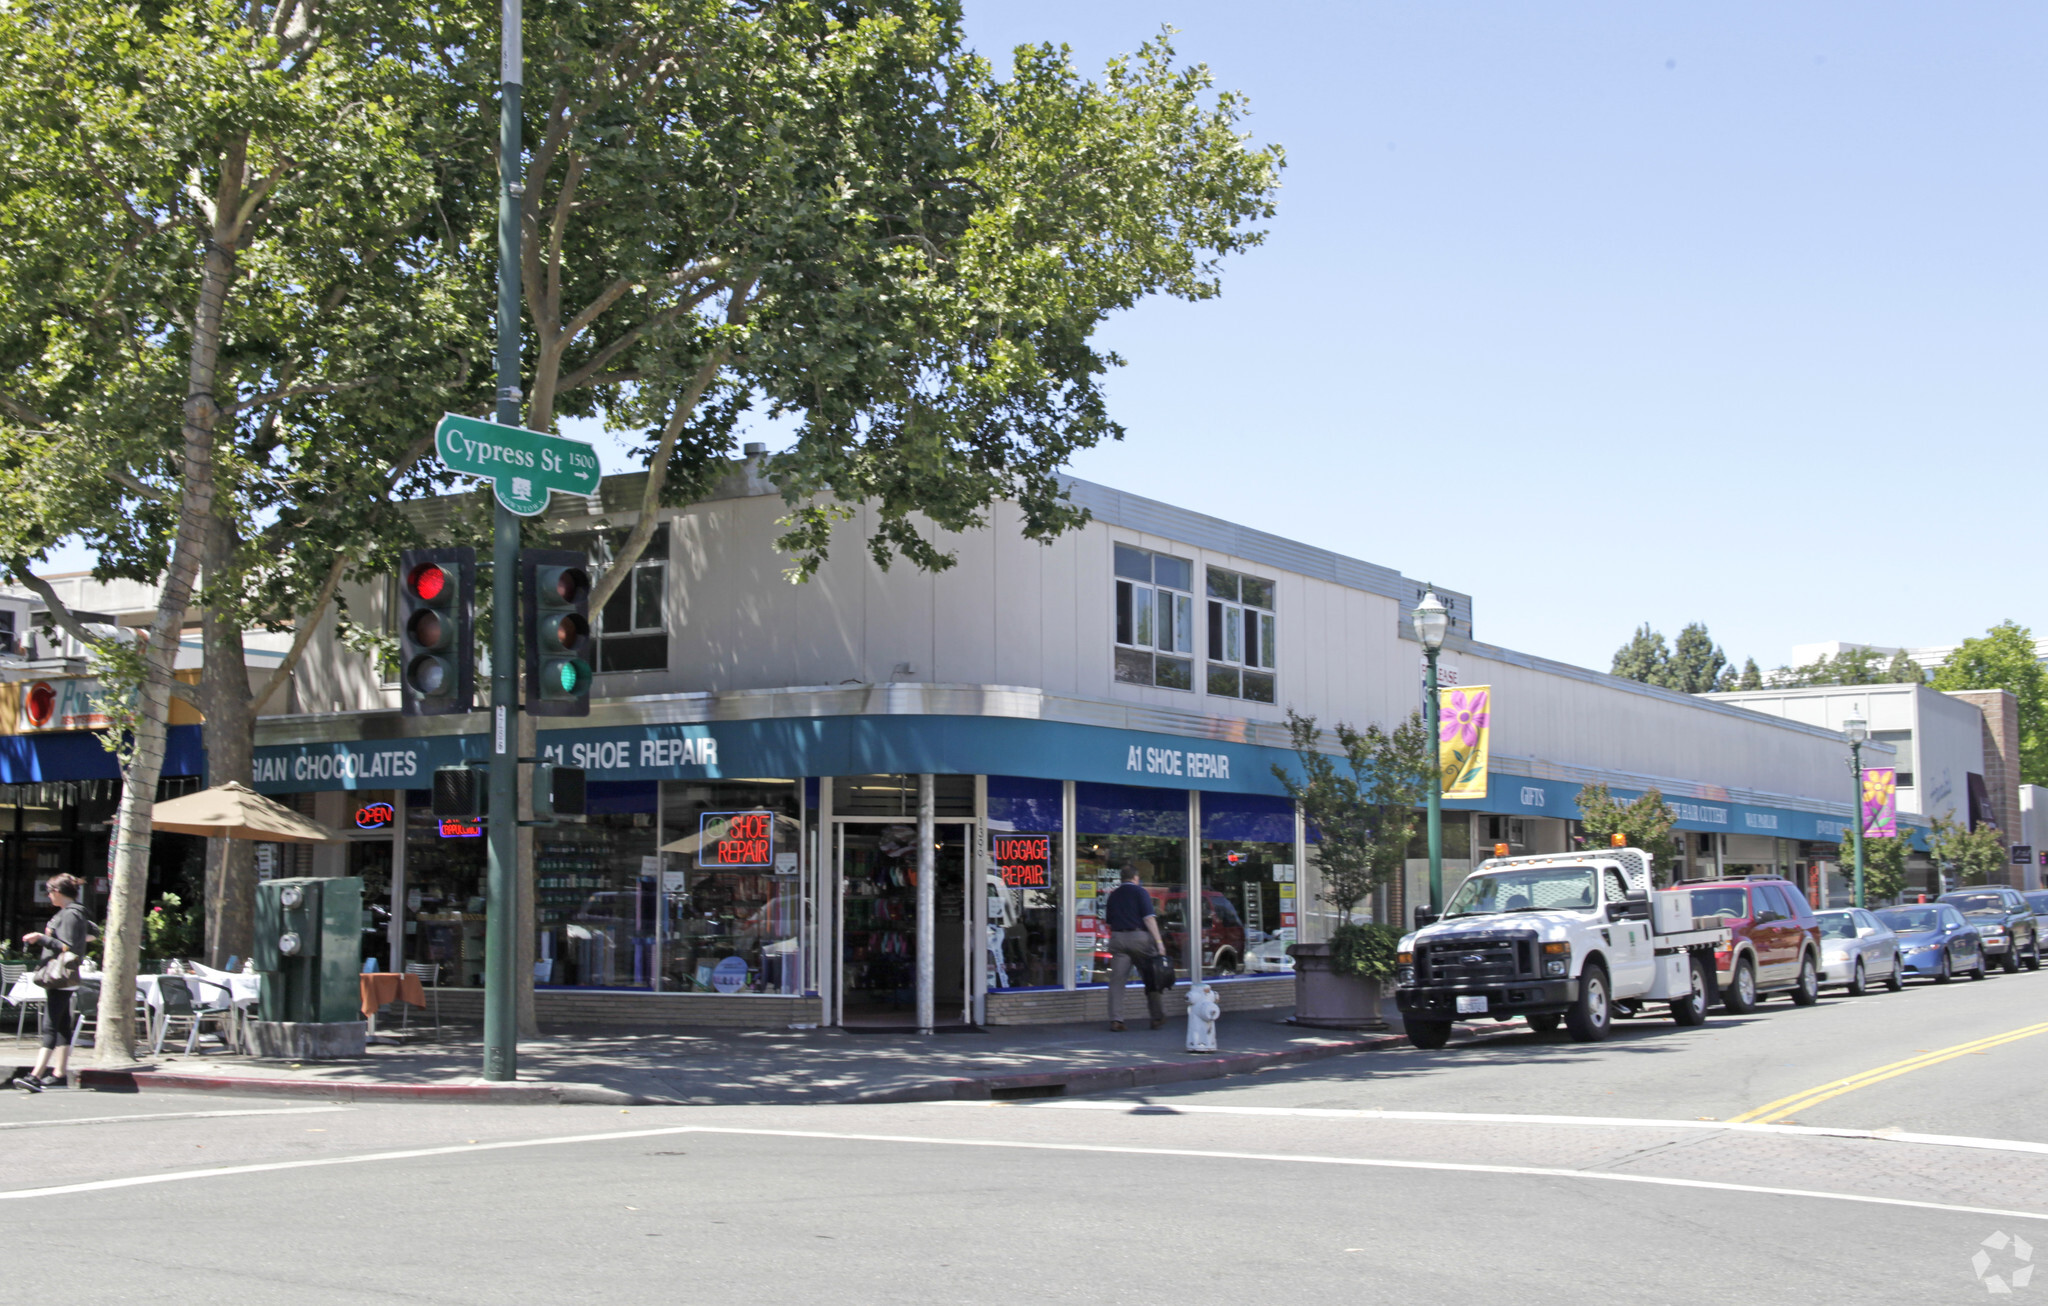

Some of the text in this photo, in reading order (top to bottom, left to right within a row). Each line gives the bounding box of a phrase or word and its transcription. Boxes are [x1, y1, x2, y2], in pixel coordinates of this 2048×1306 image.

[446, 429, 562, 473] Cypress St
[569, 452, 595, 469] 1500
[542, 737, 718, 769] A1 SHOE REPAIR
[1126, 745, 1230, 779] A1 SHOE REPAIR
[295, 750, 417, 780] CHOCOLATES
[1520, 786, 1545, 807] GIFTS
[355, 807, 392, 824] OPEN
[730, 815, 770, 839] SHOE
[718, 840, 768, 863] REPAIR
[995, 839, 1048, 861] LUGGAGE
[1001, 865, 1044, 886] REPAIR
